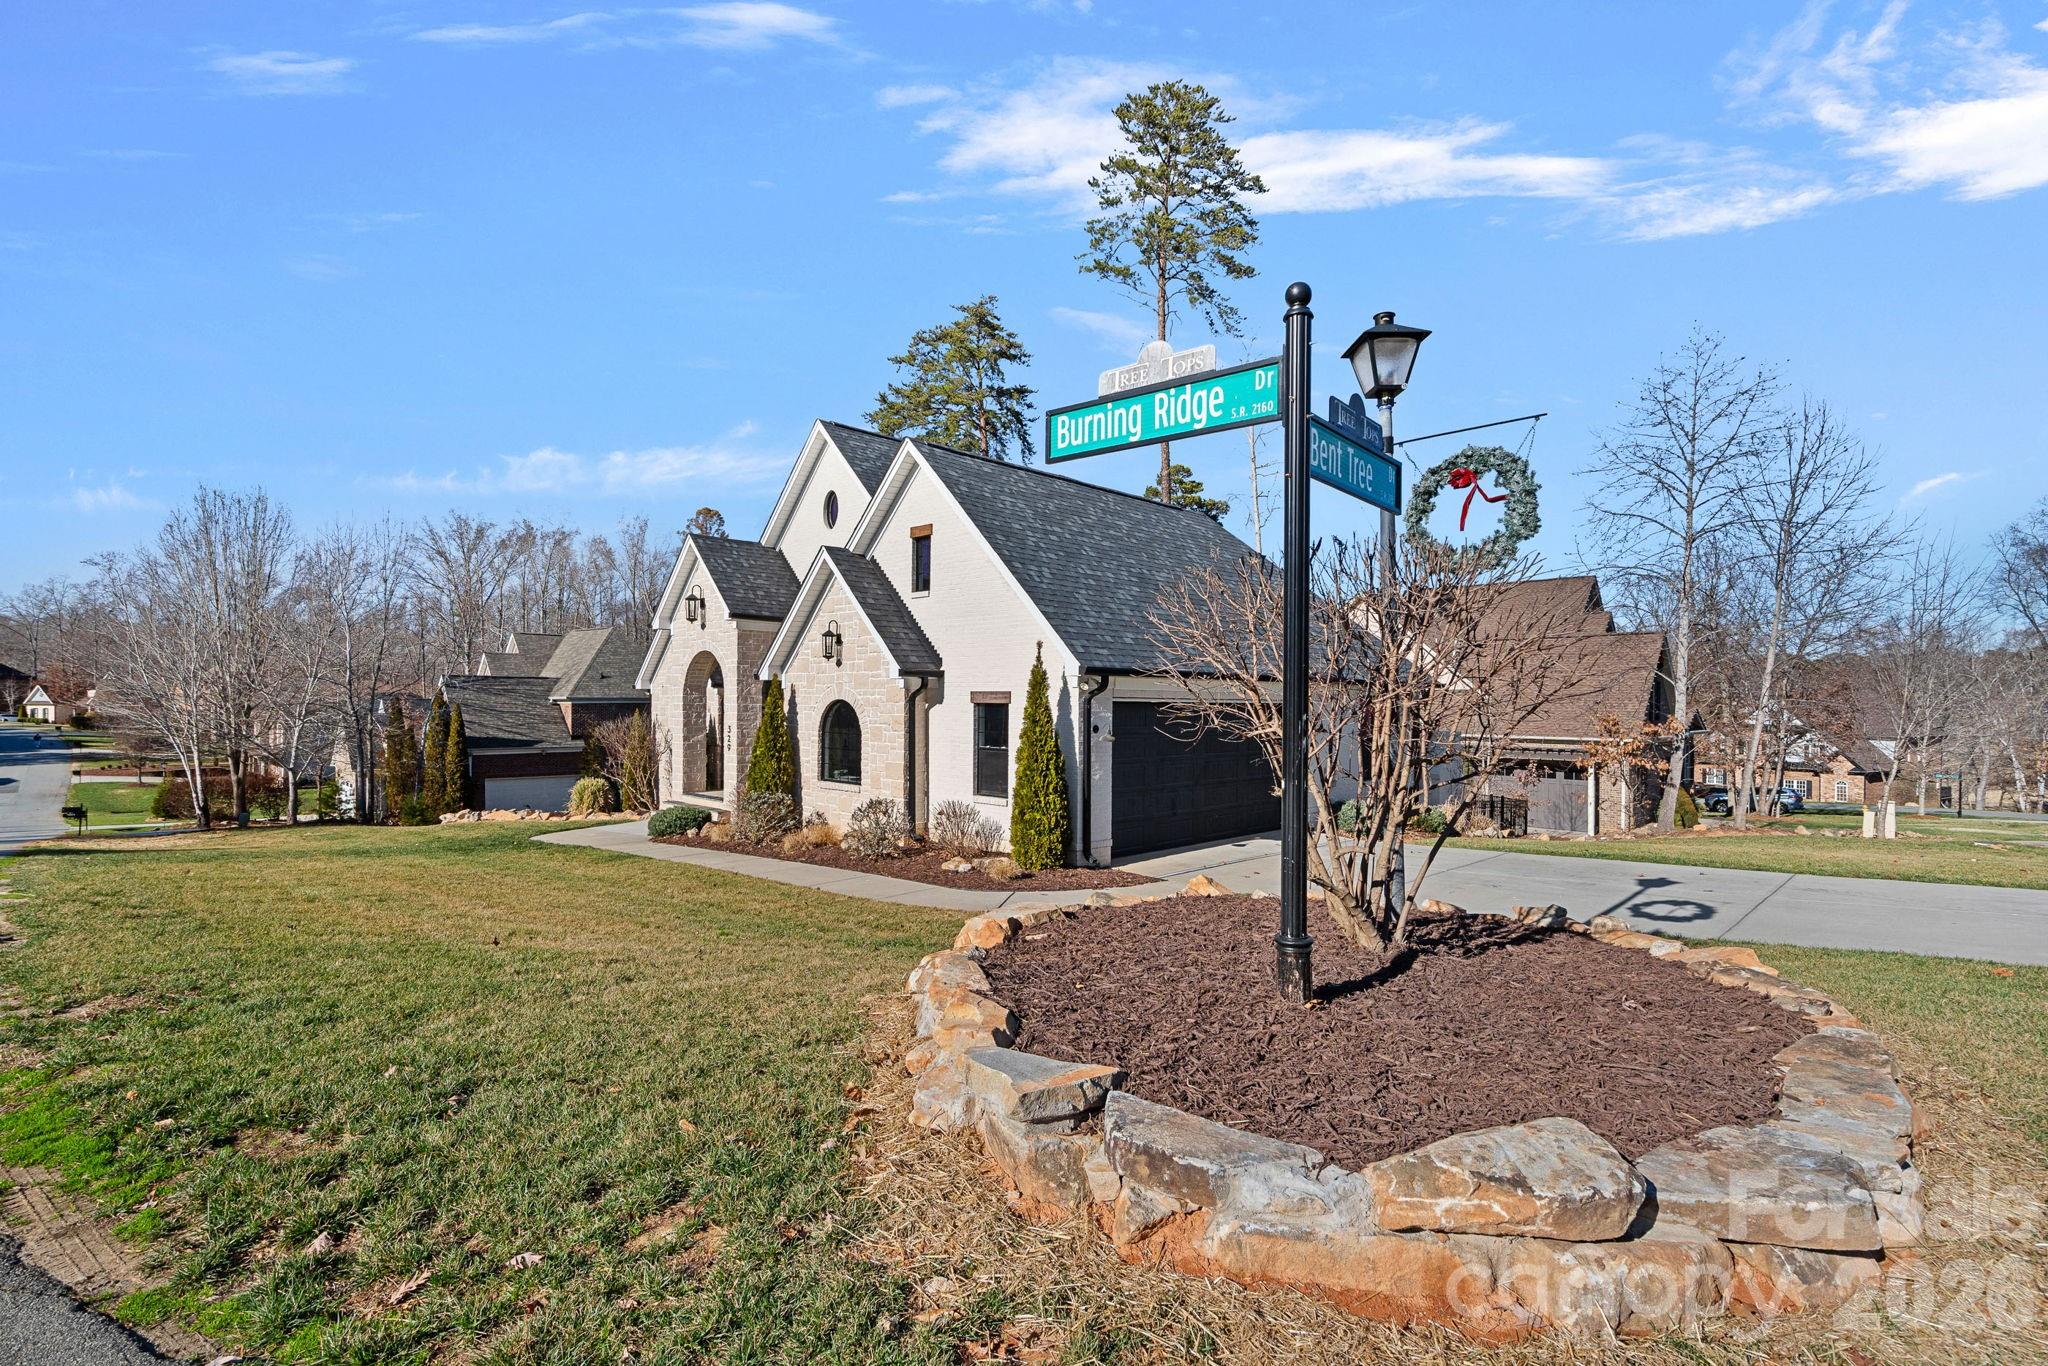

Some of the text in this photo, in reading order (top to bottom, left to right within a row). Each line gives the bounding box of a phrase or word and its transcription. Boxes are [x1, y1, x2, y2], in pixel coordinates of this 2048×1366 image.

[1057, 370, 1274, 449] Burning Ridge Dr
[1251, 400, 1274, 416] 2160
[1310, 427, 1342, 479] Bent
[1347, 447, 1373, 492] Tree
